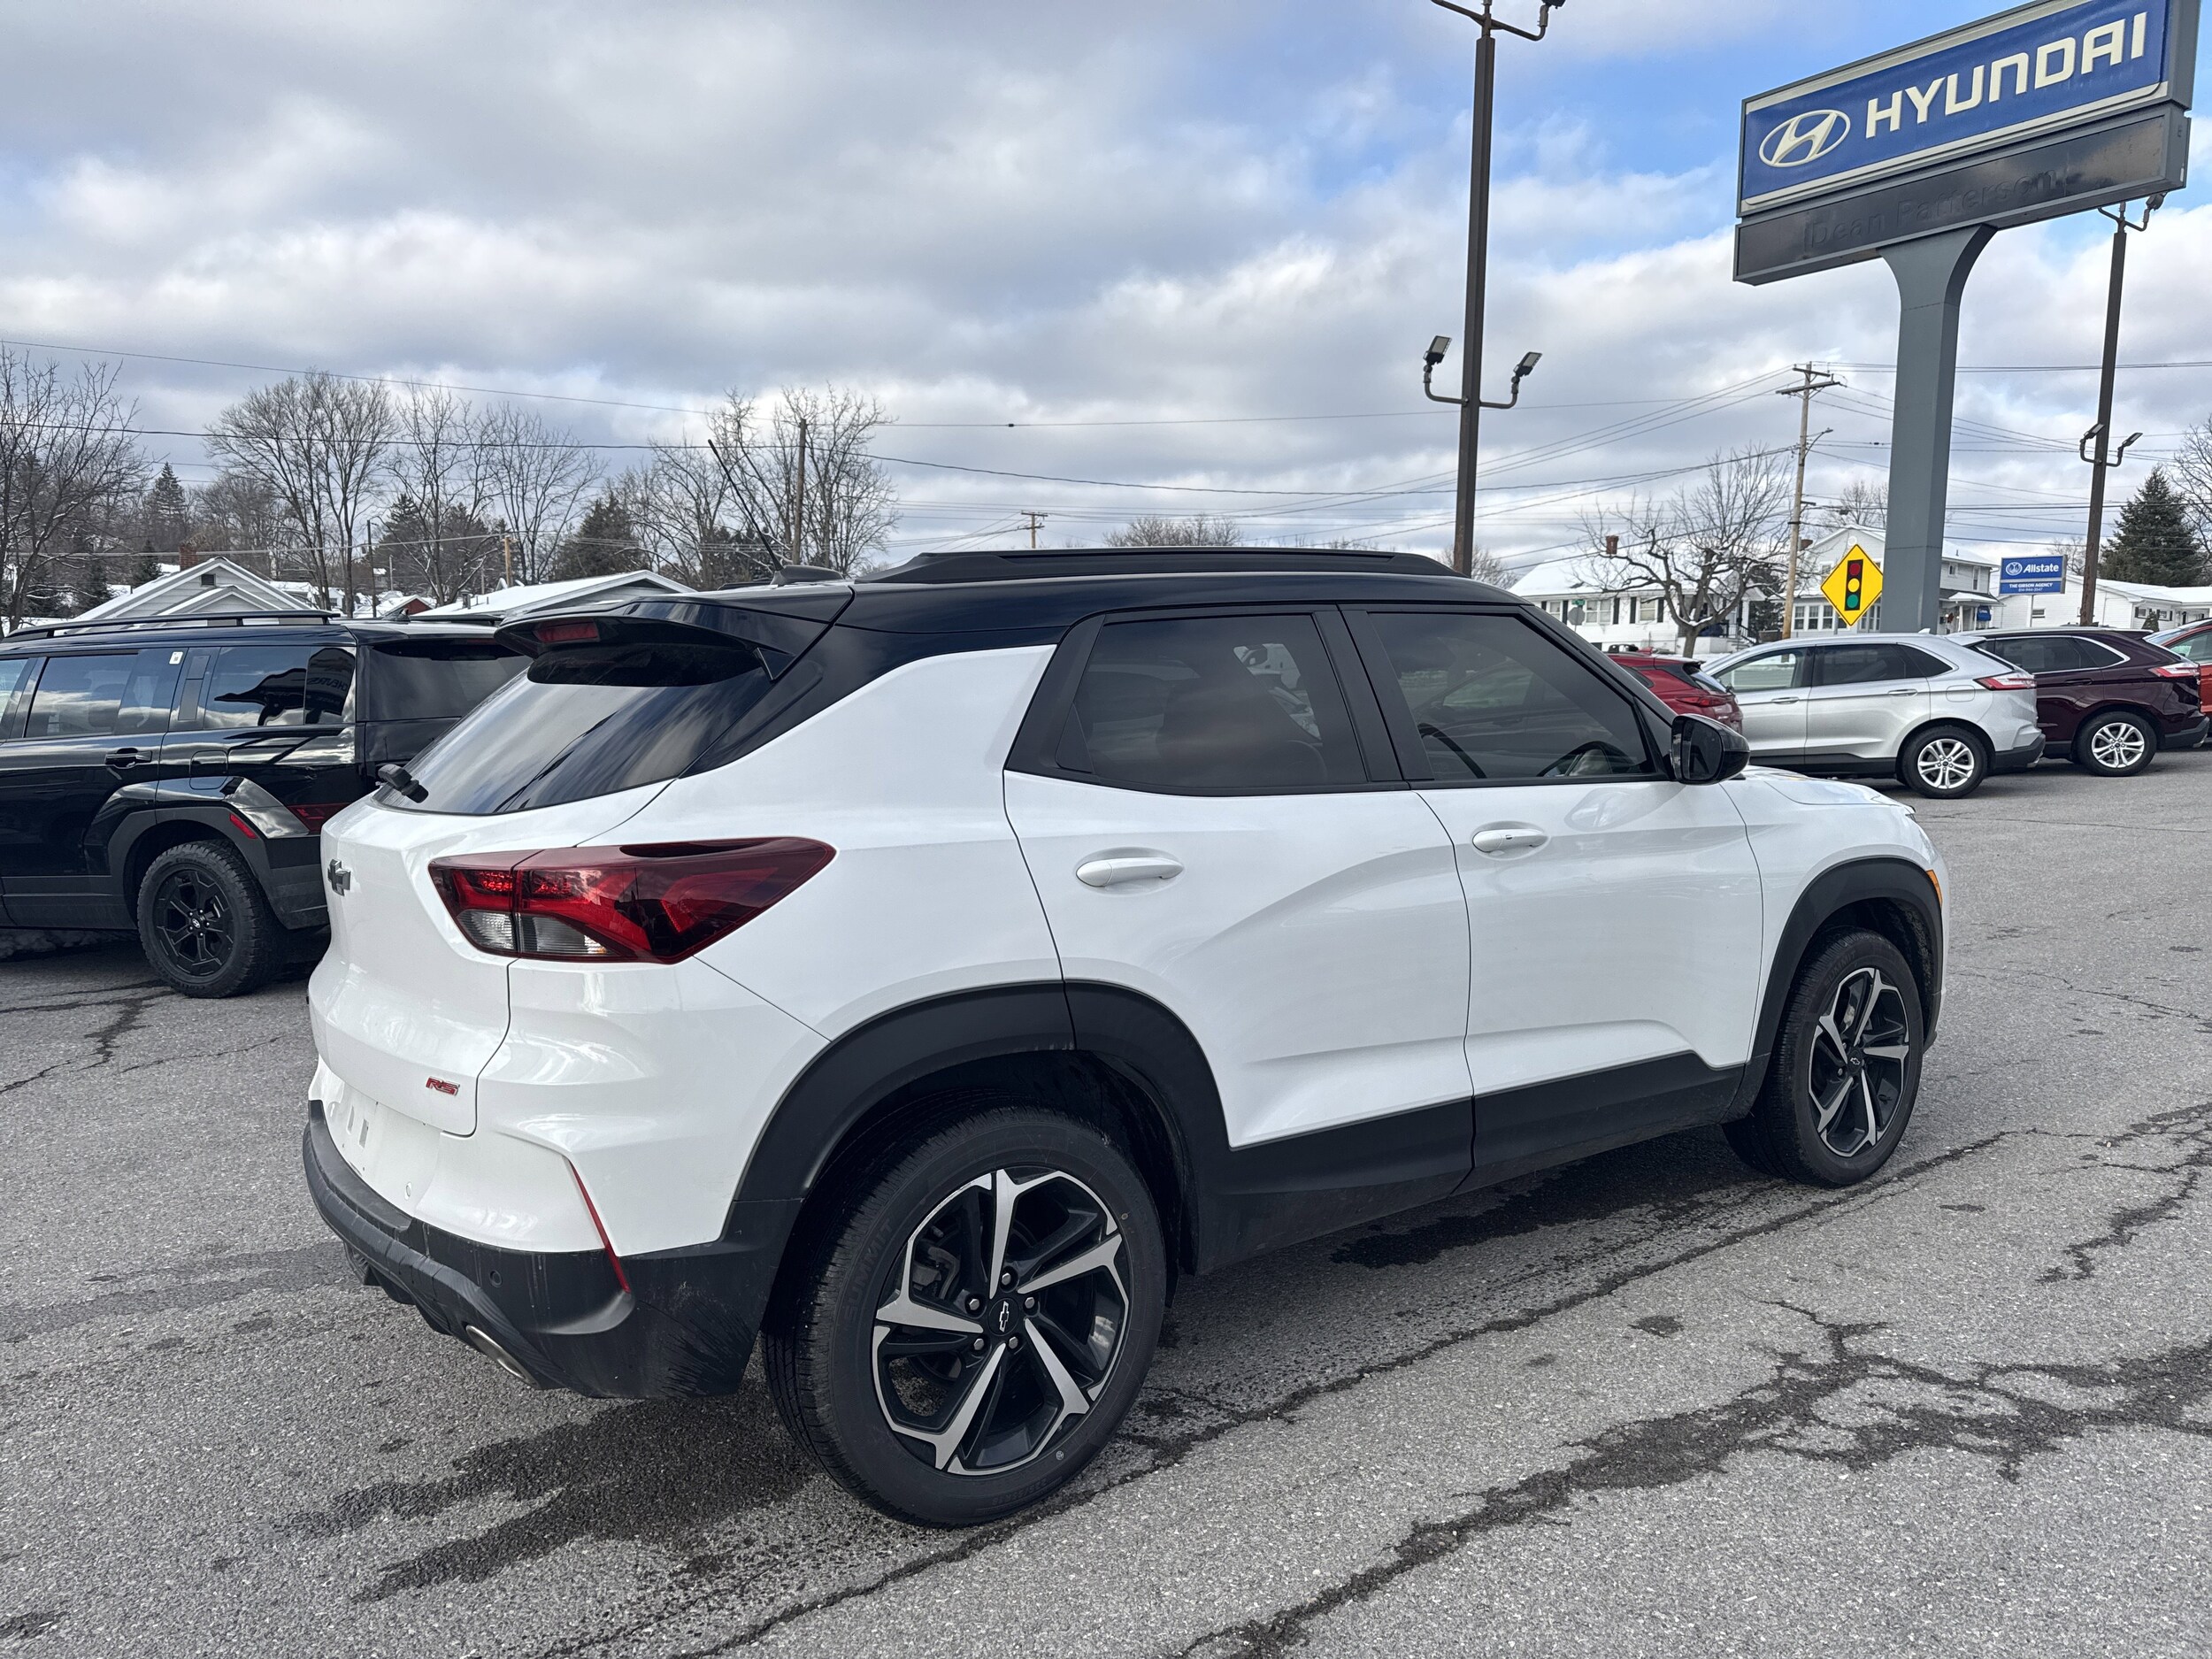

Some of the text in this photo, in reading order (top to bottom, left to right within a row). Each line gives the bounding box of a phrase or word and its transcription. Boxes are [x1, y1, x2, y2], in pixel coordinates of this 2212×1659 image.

[1865, 12, 2148, 139] HYUNDAI
[1810, 169, 2056, 247] Dean Patterson
[2024, 564, 2059, 572] Allstate
[425, 1076, 461, 1095] RS
[842, 1218, 892, 1322] SUMMIT
